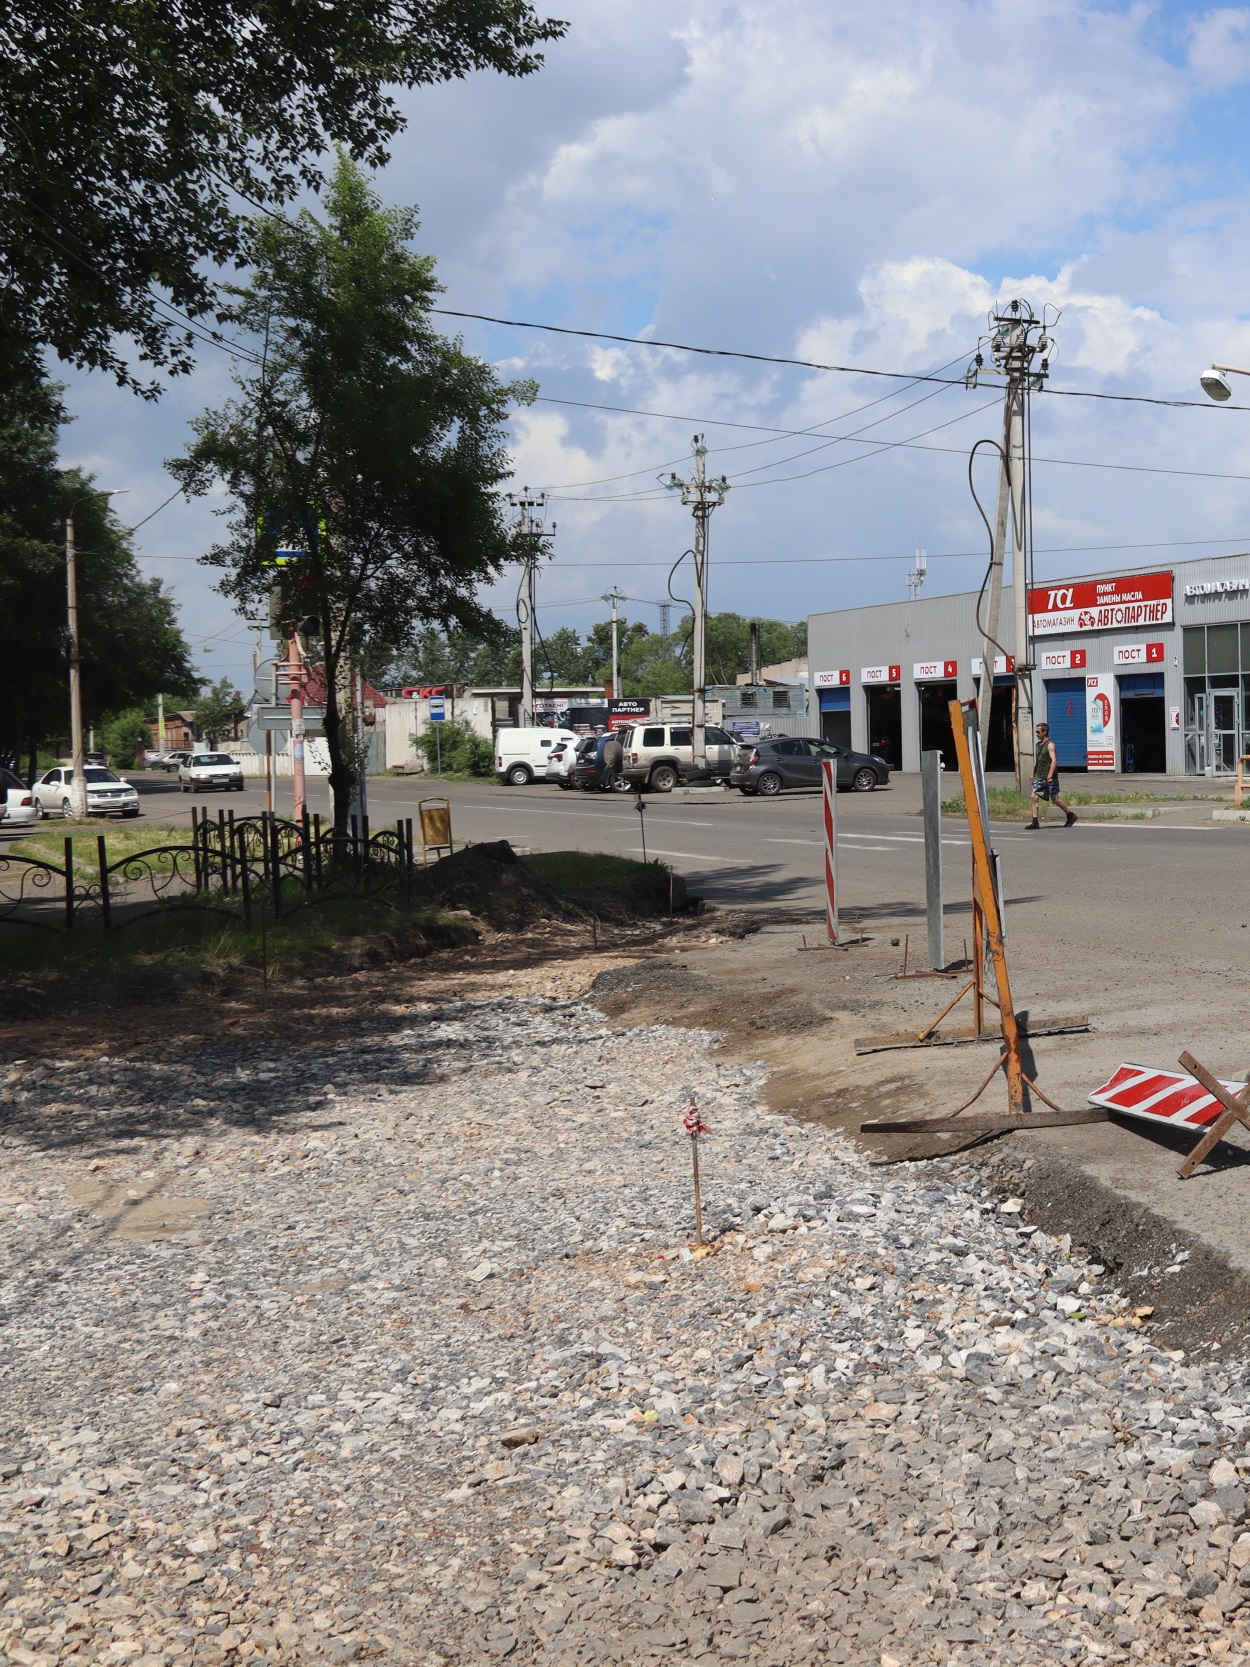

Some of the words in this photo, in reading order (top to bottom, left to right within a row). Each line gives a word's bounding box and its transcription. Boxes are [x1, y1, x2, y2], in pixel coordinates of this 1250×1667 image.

[1096, 582, 1116, 594] ПУНКТ
[1048, 588, 1074, 610] TCL
[1096, 594, 1122, 605] ЗАМЕНЫ
[1122, 591, 1143, 602] МАСЛА
[1032, 616, 1075, 630] АВТОМАГАЗИН
[1097, 601, 1168, 626] АВТОПАРТНЁР
[1046, 655, 1066, 666] ПОСТ
[1076, 654, 1081, 664] 2
[1118, 648, 1142, 660] ПОСТ
[1152, 648, 1158, 658] 1
[866, 670, 882, 678] ПОСТ
[892, 668, 896, 678] 5
[920, 665, 938, 675] ПОСТ
[947, 664, 952, 674] 4
[820, 674, 834, 683] ПОСТ
[842, 673, 846, 682] 6
[1067, 702, 1073, 716] 2
